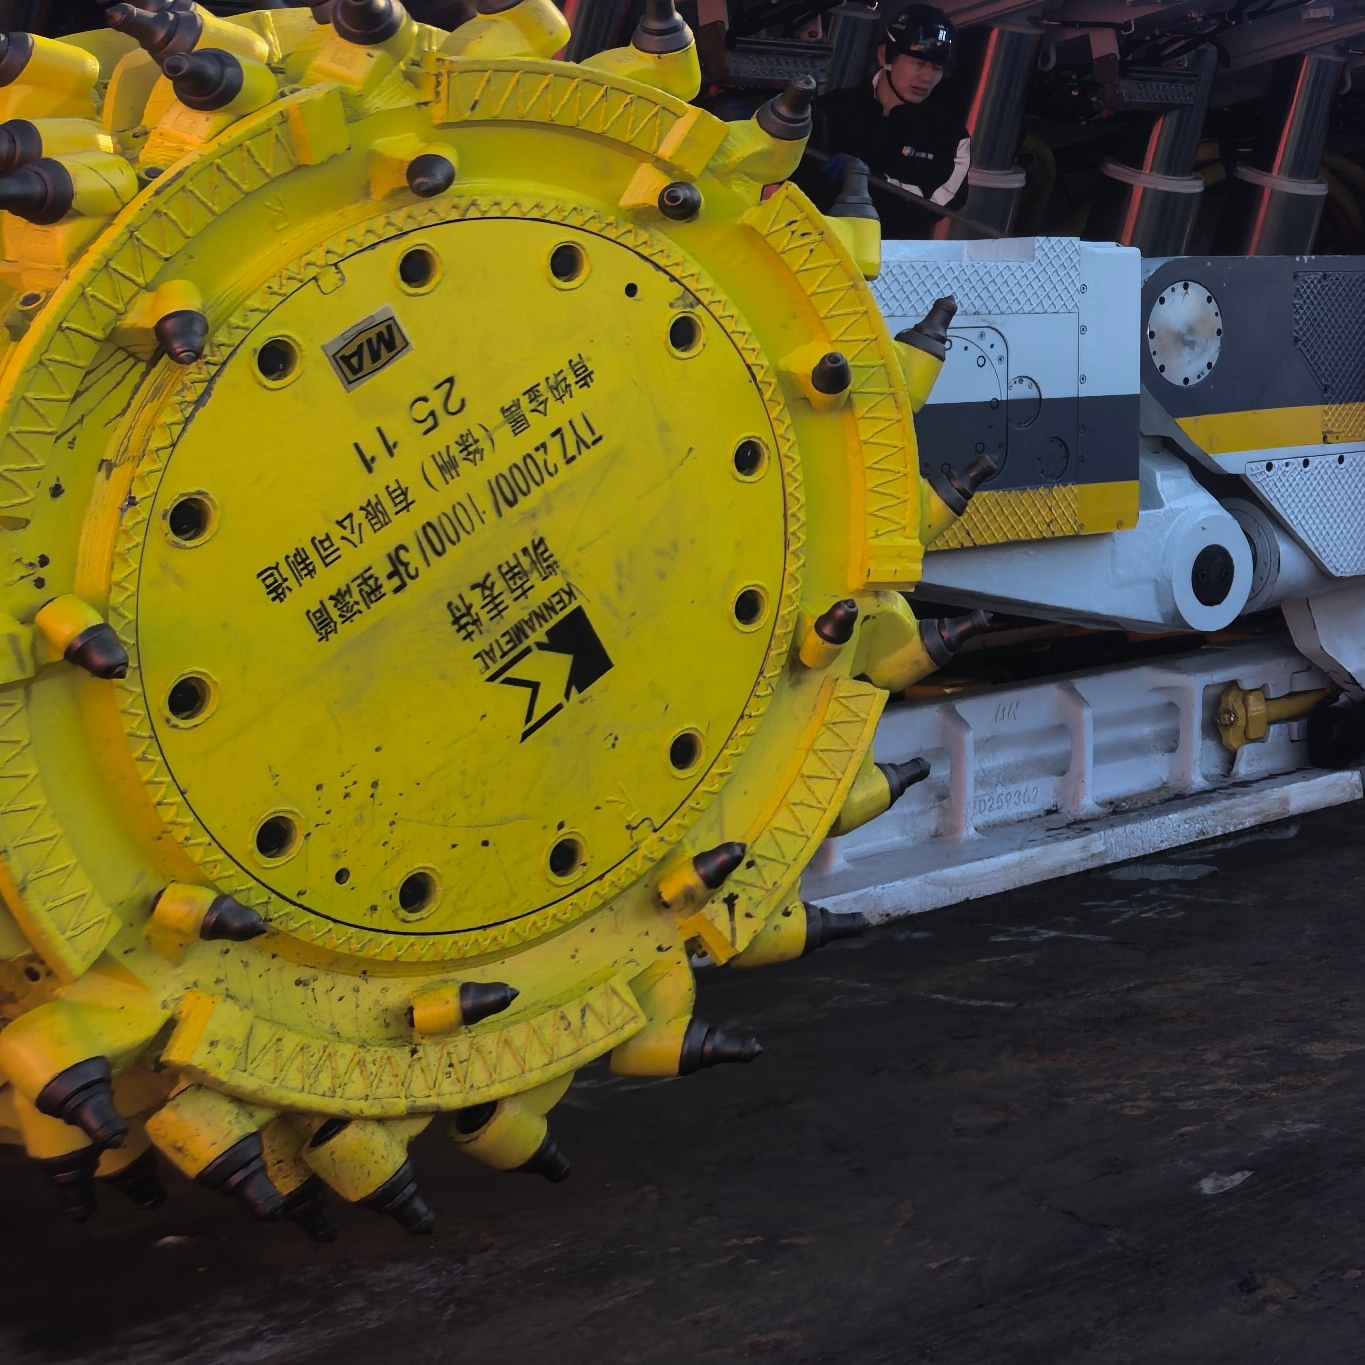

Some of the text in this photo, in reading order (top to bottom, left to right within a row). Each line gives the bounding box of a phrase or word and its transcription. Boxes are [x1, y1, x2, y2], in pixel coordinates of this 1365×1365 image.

[340, 316, 398, 378] MA
[351, 374, 467, 475] 25 11
[445, 536, 560, 644] 凯南麦特
[471, 581, 578, 675] KENNAMETAL
